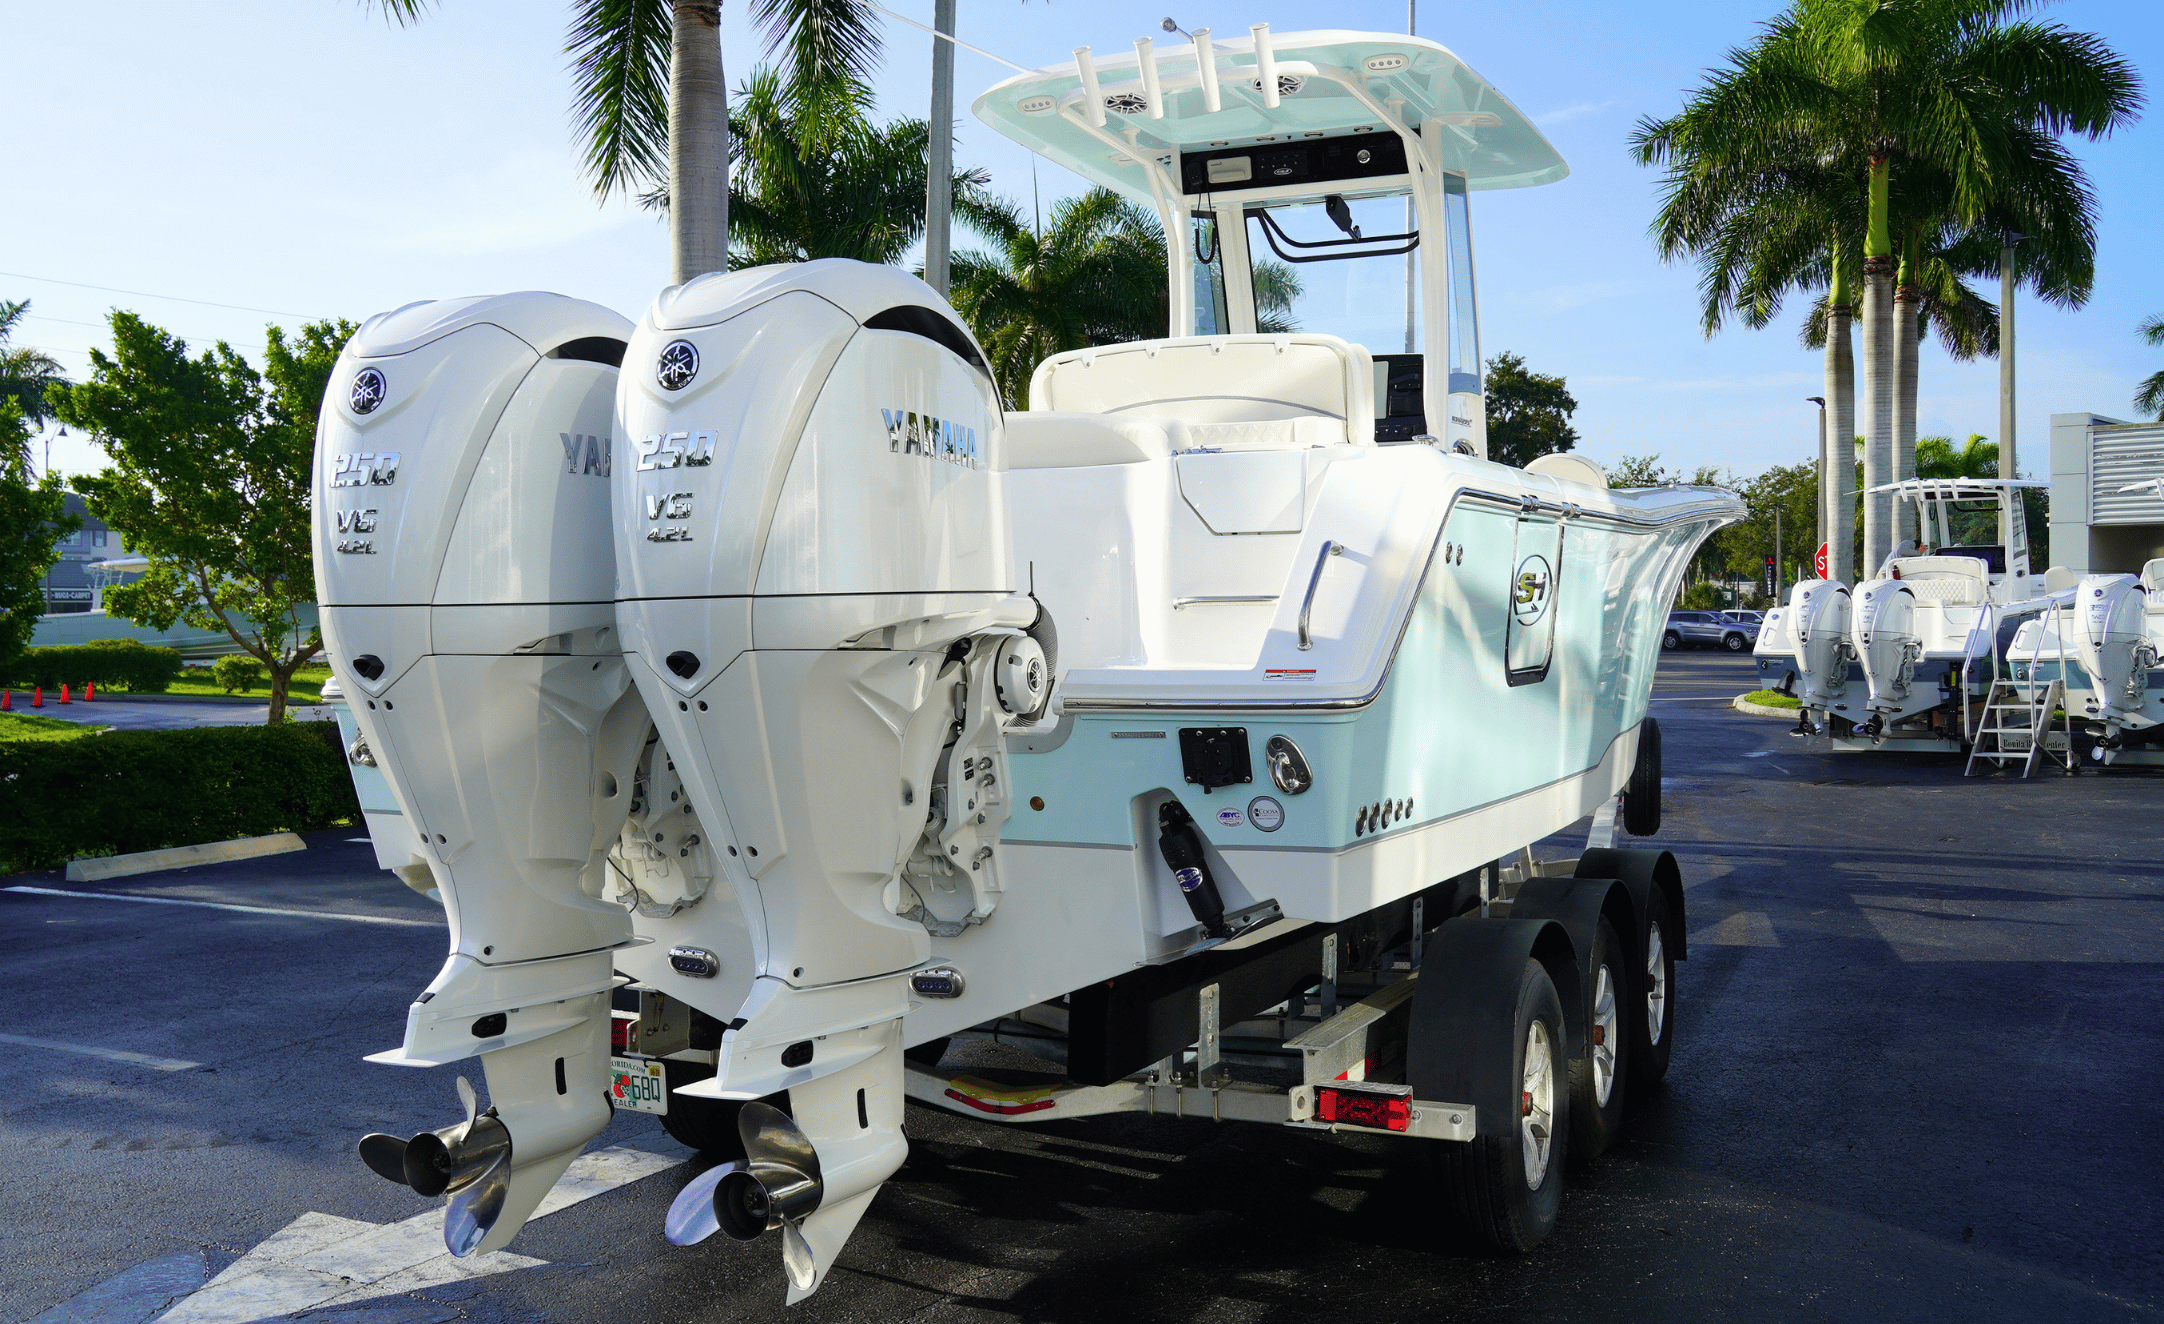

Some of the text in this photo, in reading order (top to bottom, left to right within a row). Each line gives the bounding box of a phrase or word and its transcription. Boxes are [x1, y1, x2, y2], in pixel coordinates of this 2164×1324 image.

[636, 430, 719, 472] 250
[881, 407, 977, 470] YAMAHA
[329, 451, 402, 488] 250
[645, 492, 695, 520] V6
[337, 509, 379, 534] V6
[647, 526, 694, 543] 4.2L
[337, 540, 378, 555] 4.2L
[2046, 740, 2066, 749] enter
[613, 1098, 638, 1108] EALER
